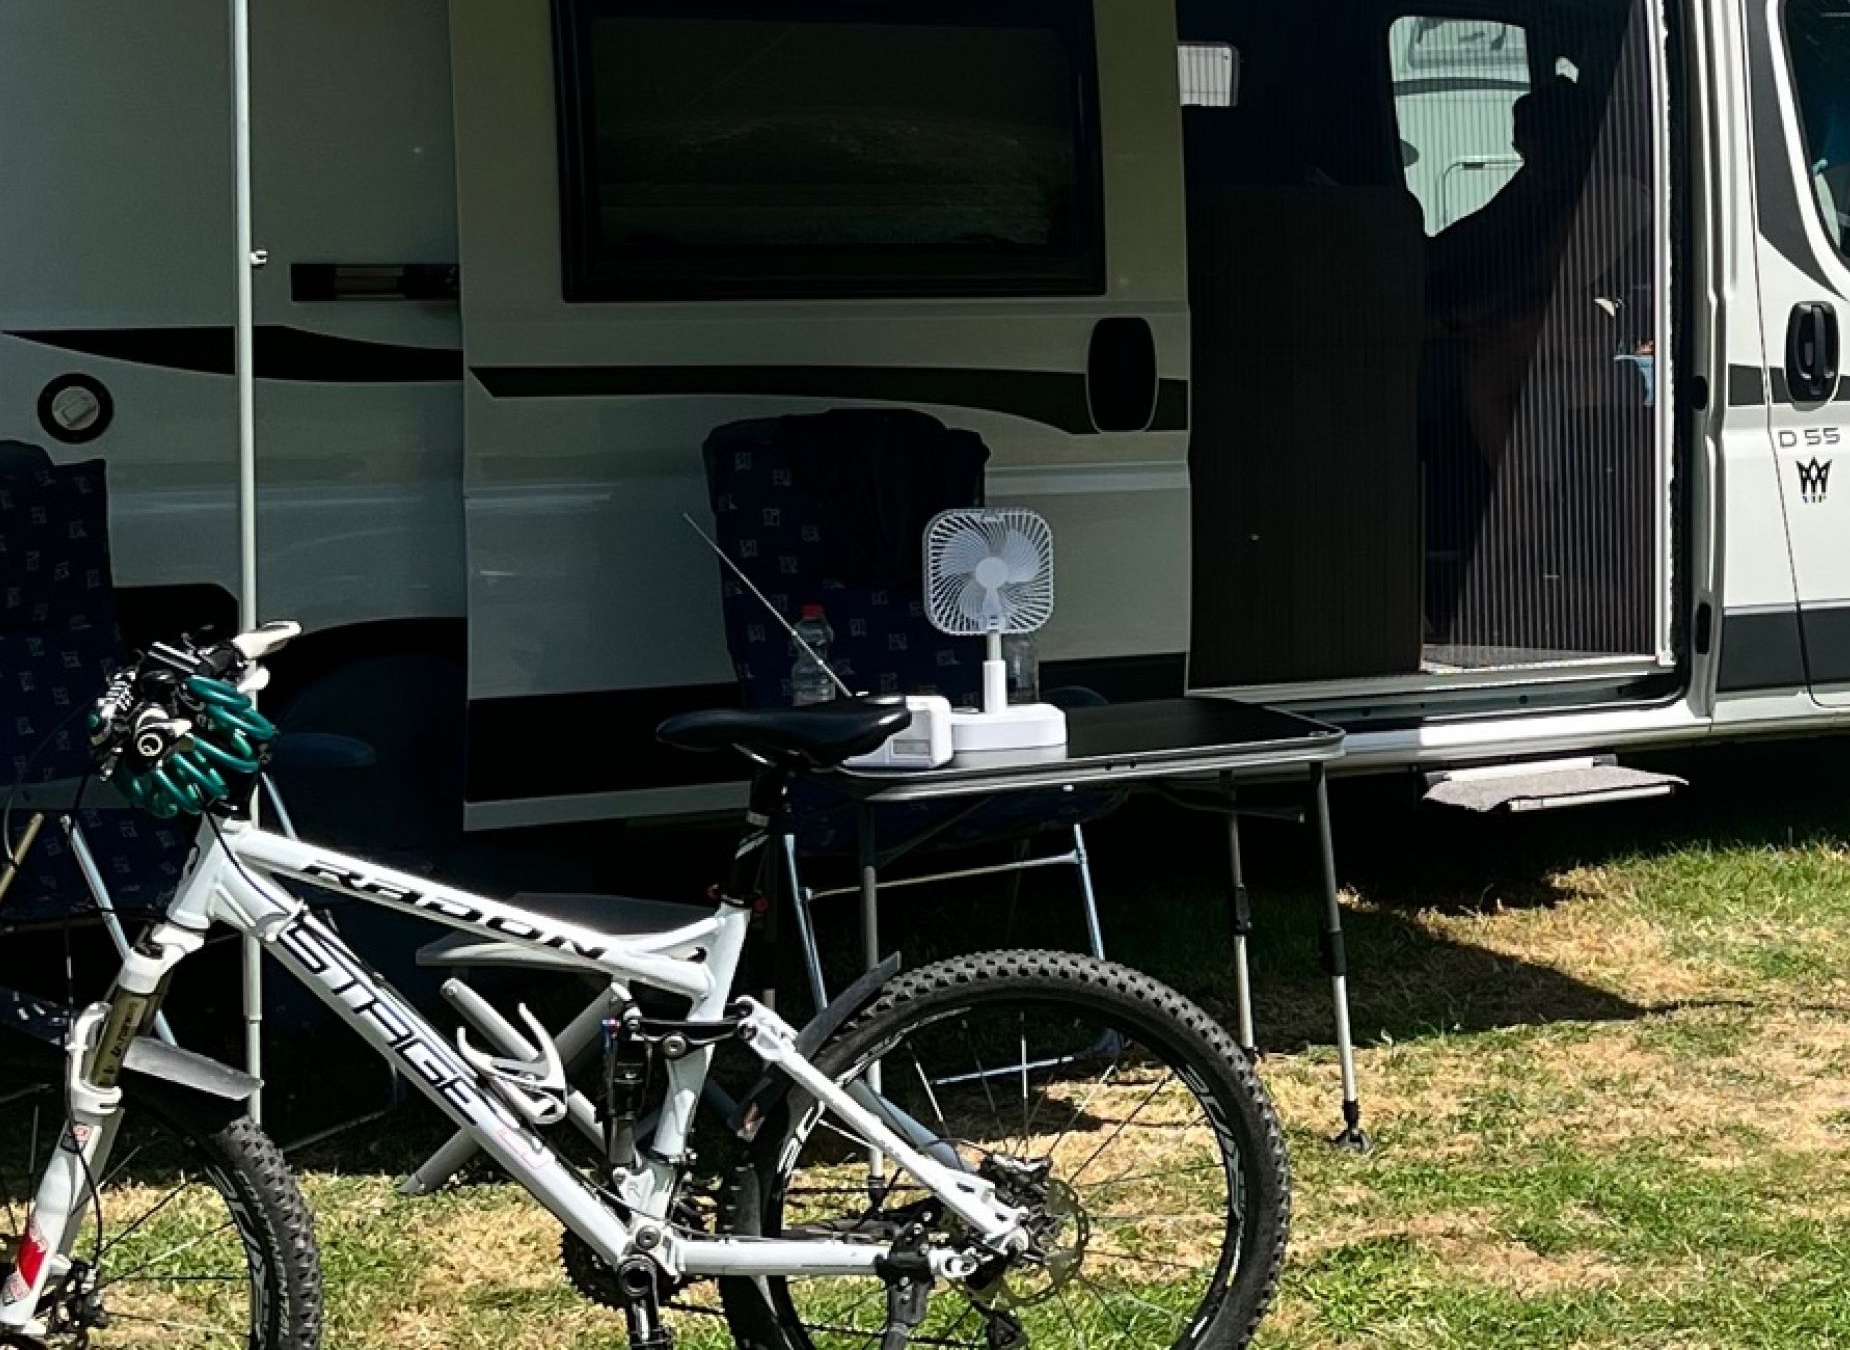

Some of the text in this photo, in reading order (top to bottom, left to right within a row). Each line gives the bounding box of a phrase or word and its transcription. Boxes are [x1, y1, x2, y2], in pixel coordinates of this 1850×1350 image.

[1779, 430, 1798, 448] D
[301, 858, 606, 961] RADON
[276, 912, 479, 1127] STAGE
